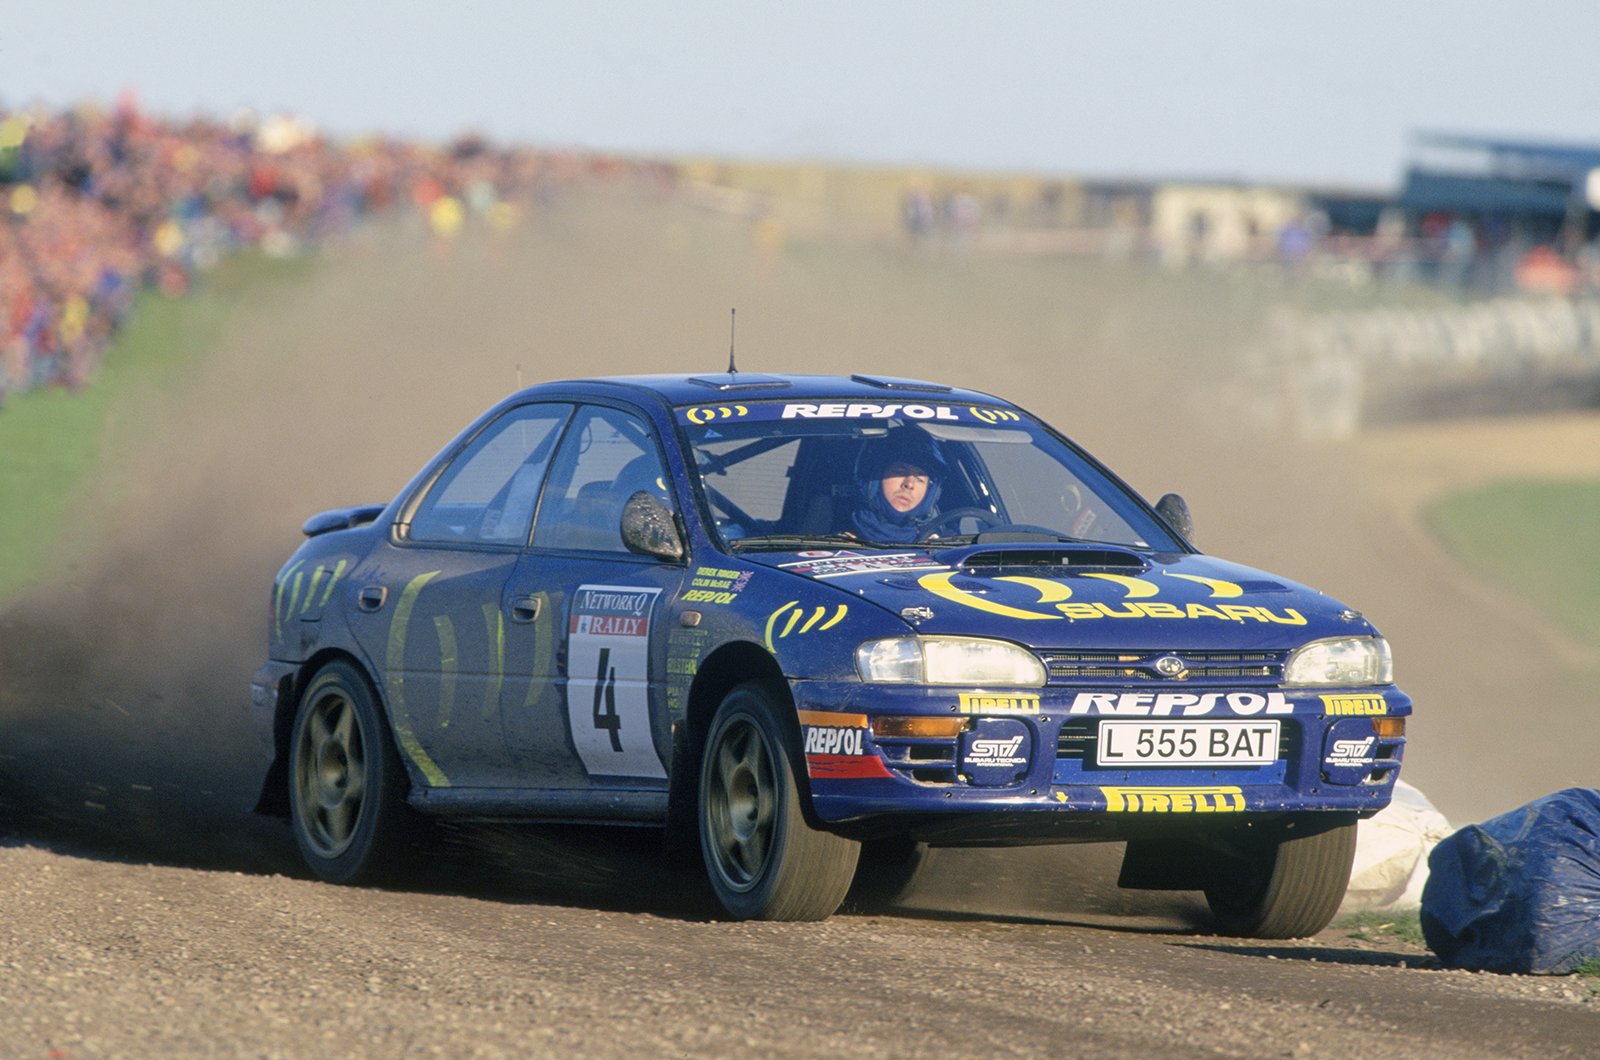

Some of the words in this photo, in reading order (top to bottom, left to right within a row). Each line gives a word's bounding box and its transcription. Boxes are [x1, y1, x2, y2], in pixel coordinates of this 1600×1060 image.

[782, 404, 959, 420] REPSOL
[691, 578, 711, 587] COLIN
[696, 567, 718, 577] DEREK
[716, 569, 741, 579] RINGER
[681, 589, 738, 604] REPSOL
[1055, 602, 1308, 625] SUBARU
[590, 616, 642, 635] RALLY
[593, 648, 624, 753] 4
[958, 692, 1040, 714] PIRELLI
[1070, 692, 1295, 716] REPSOL
[1318, 693, 1387, 715] PIRELLI
[804, 727, 864, 755] REPSOL
[1106, 728, 1124, 758] L
[1135, 728, 1198, 758] 555
[1208, 728, 1273, 758] BAT
[1100, 786, 1246, 812] PIRELLI
